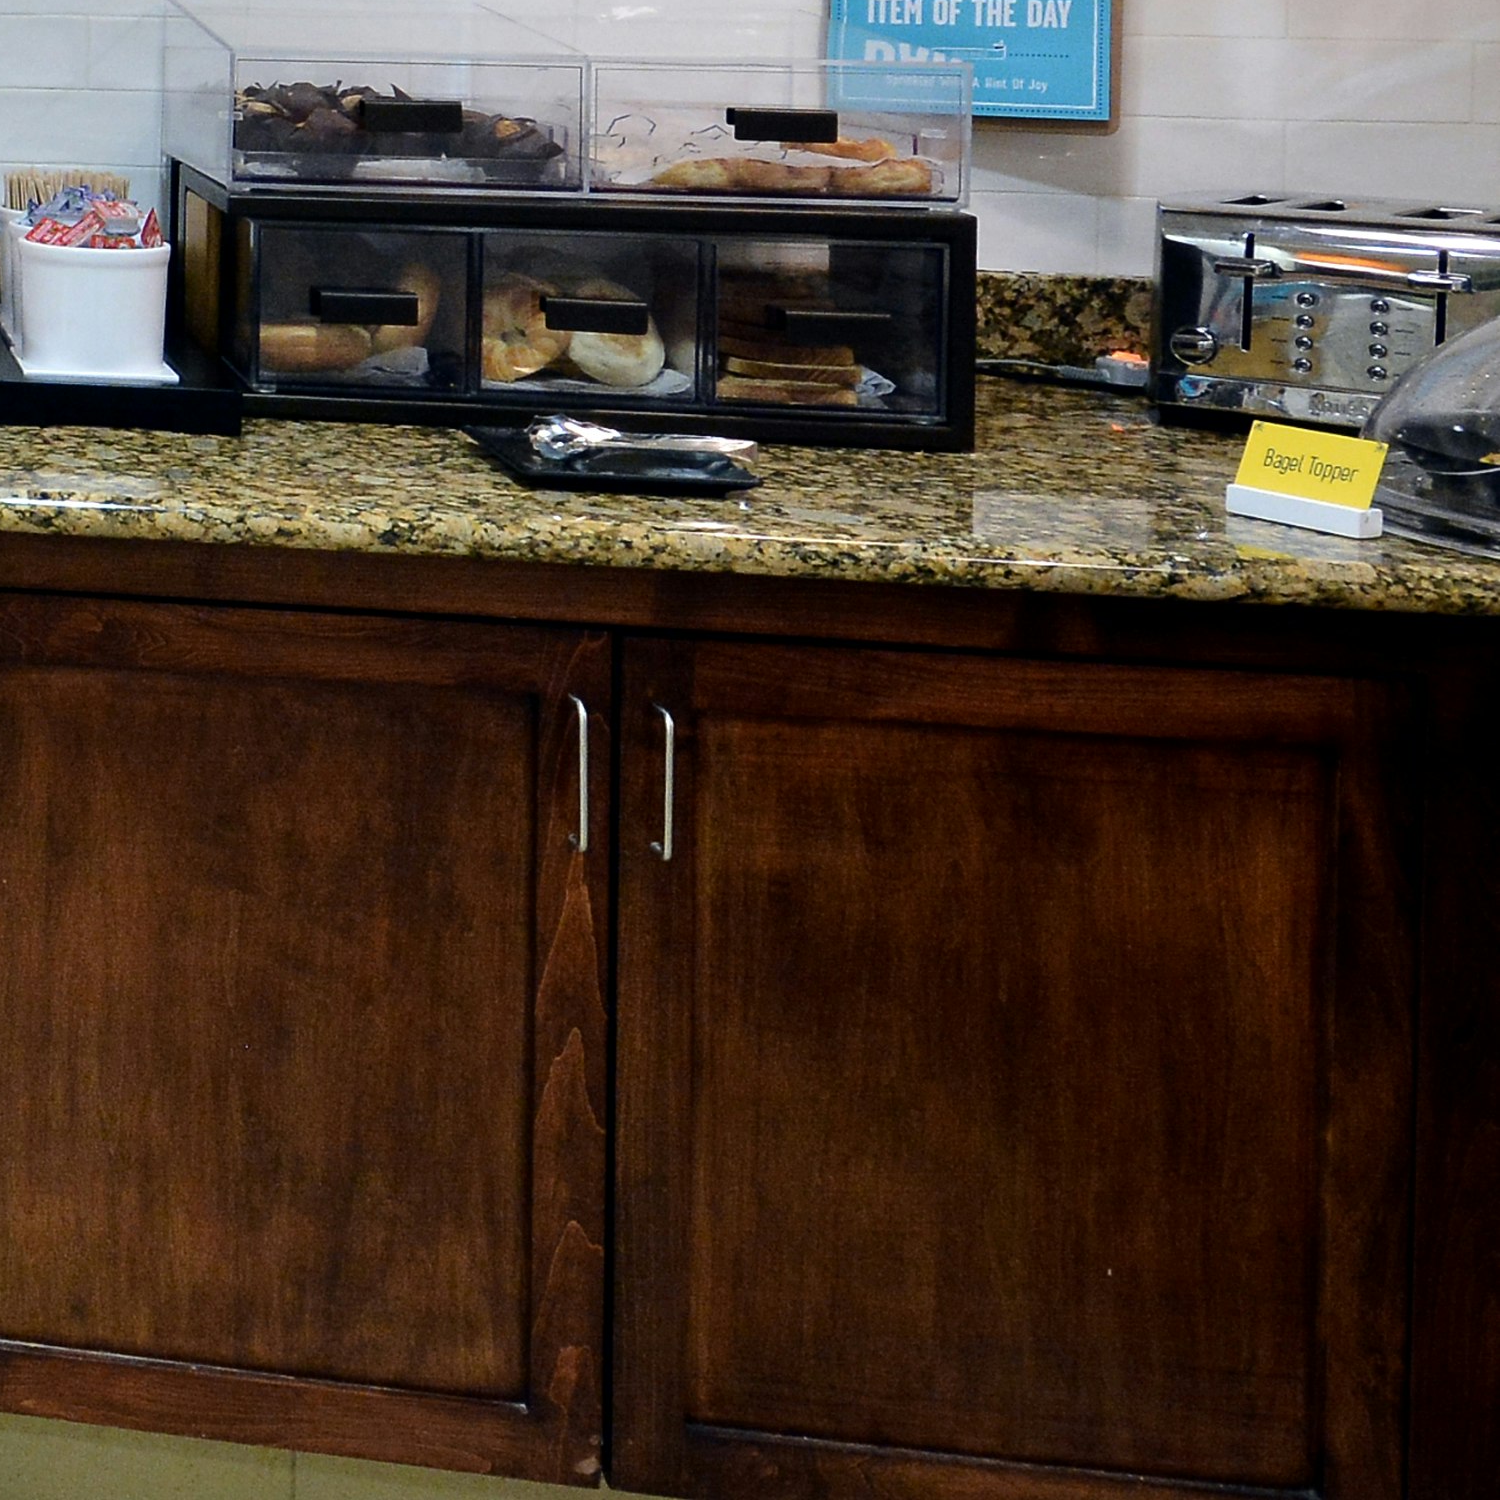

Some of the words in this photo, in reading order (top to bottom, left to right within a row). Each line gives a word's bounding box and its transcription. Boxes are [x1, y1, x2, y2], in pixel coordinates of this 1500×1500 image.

[1026, 0, 1073, 28] DAY
[1029, 79, 1049, 93] Joy
[1263, 448, 1304, 476] Bagel
[1307, 455, 1360, 484] Topper
